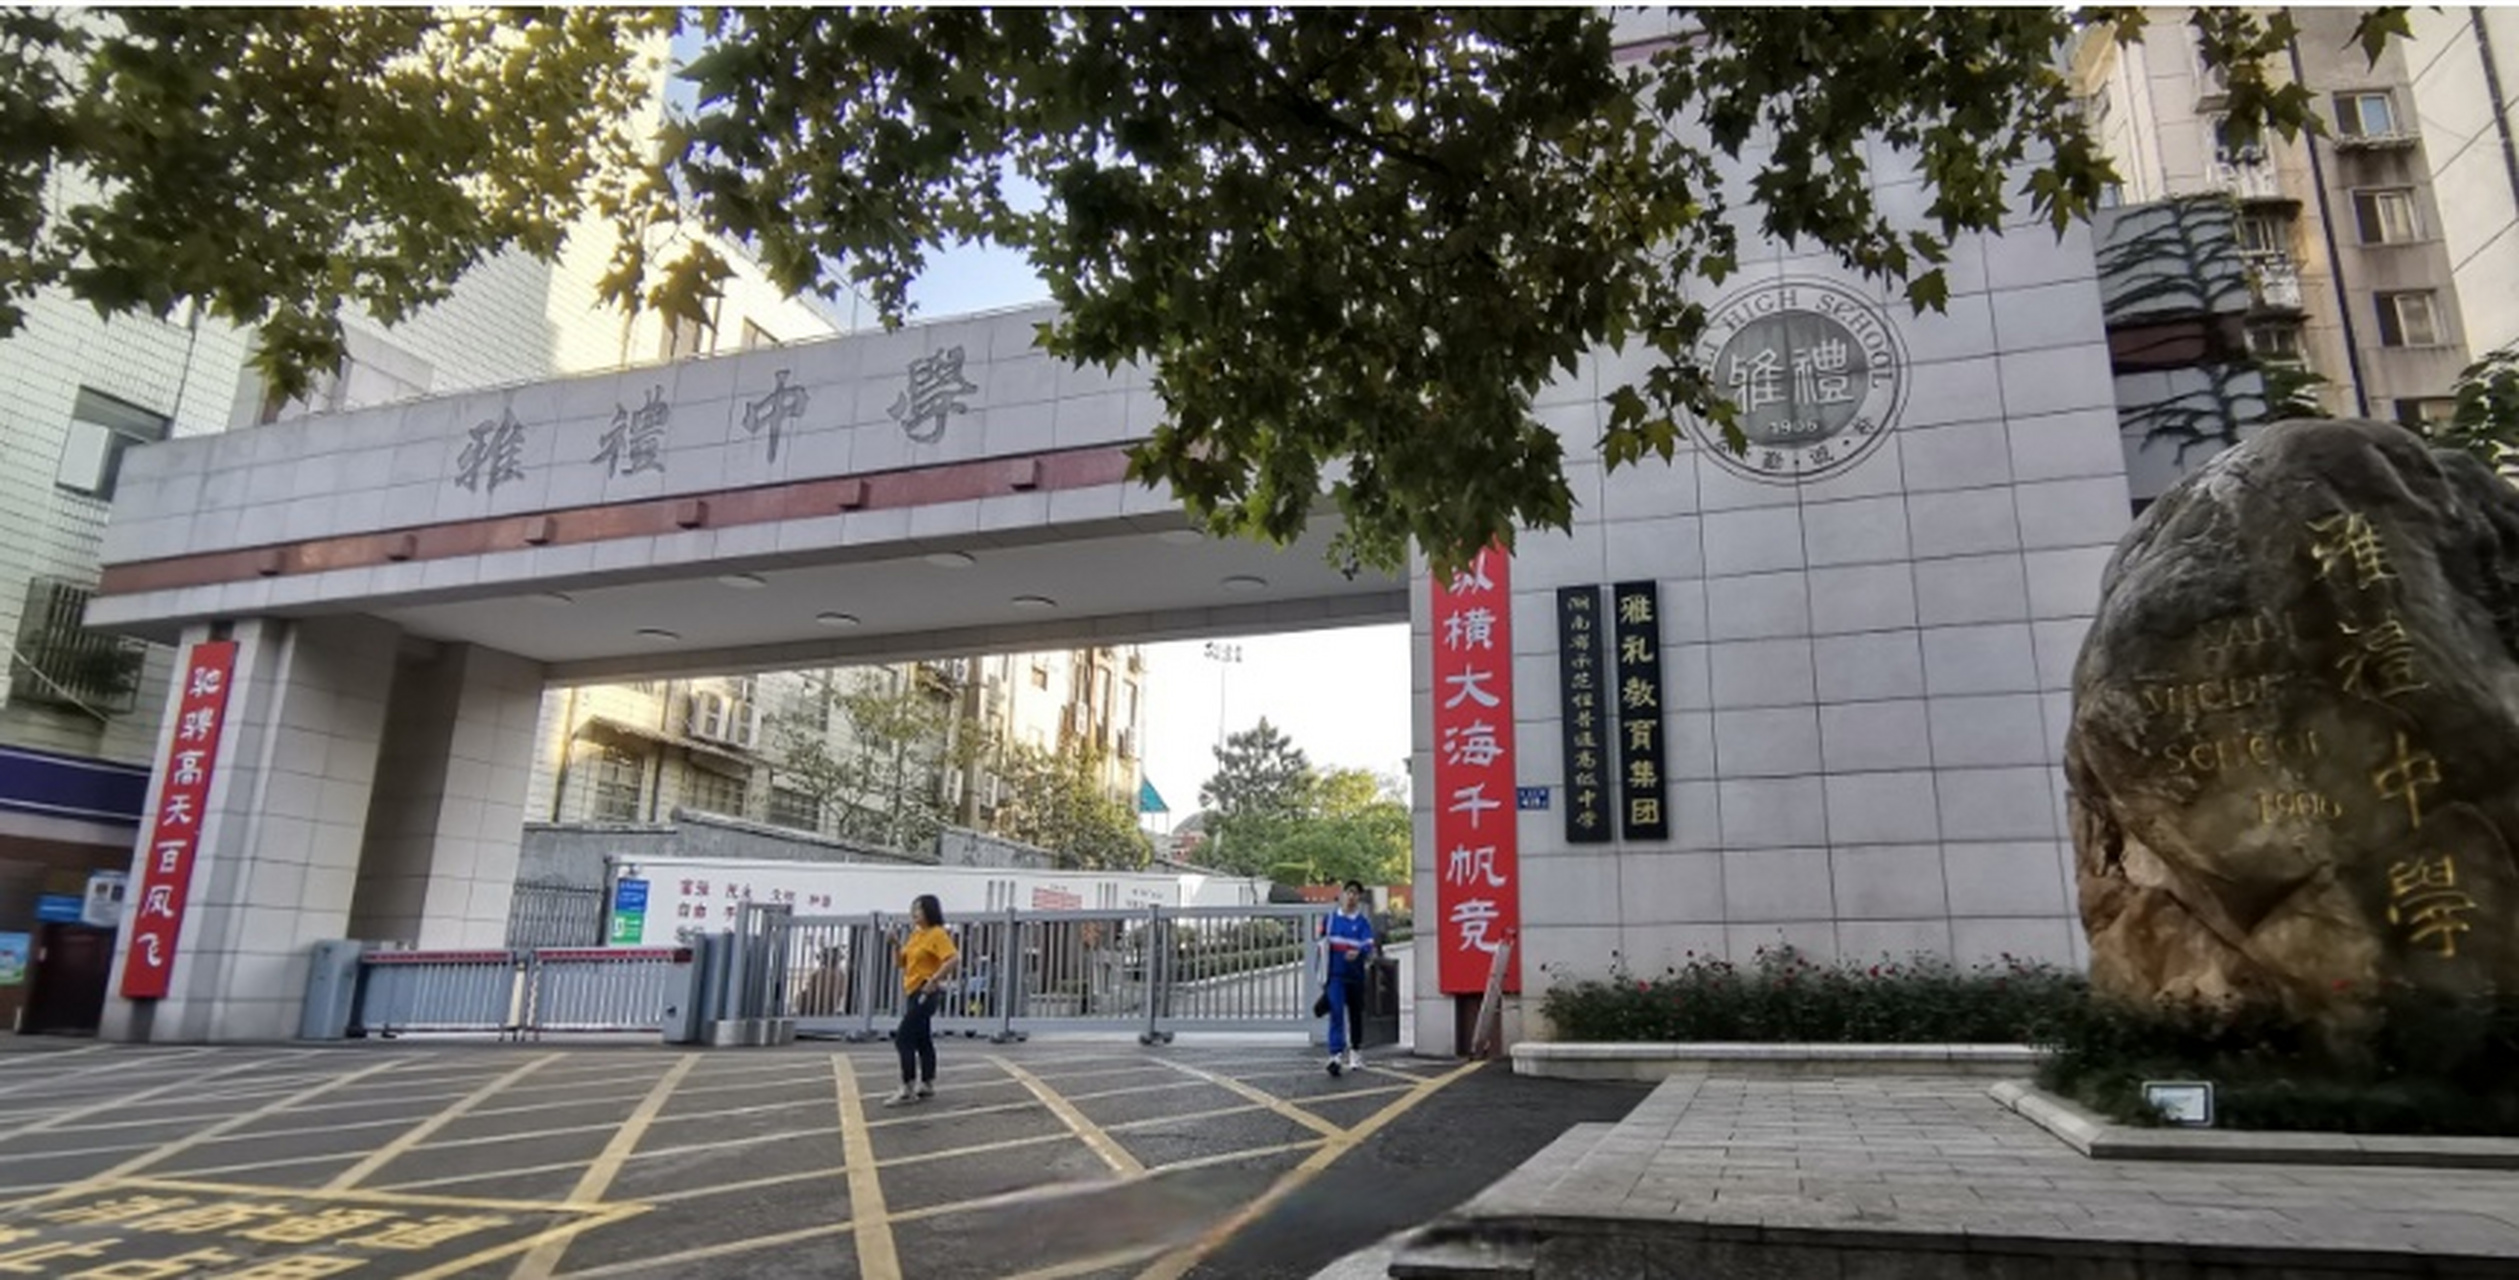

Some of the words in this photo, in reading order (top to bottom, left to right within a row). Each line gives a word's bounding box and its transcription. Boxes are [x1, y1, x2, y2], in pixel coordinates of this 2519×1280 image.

[1722, 289, 1798, 332] HIGH
[1815, 294, 1893, 388] SCHOOL
[453, 344, 978, 494] 雅禮中學
[1620, 594, 1660, 826] 雅礼教育集团
